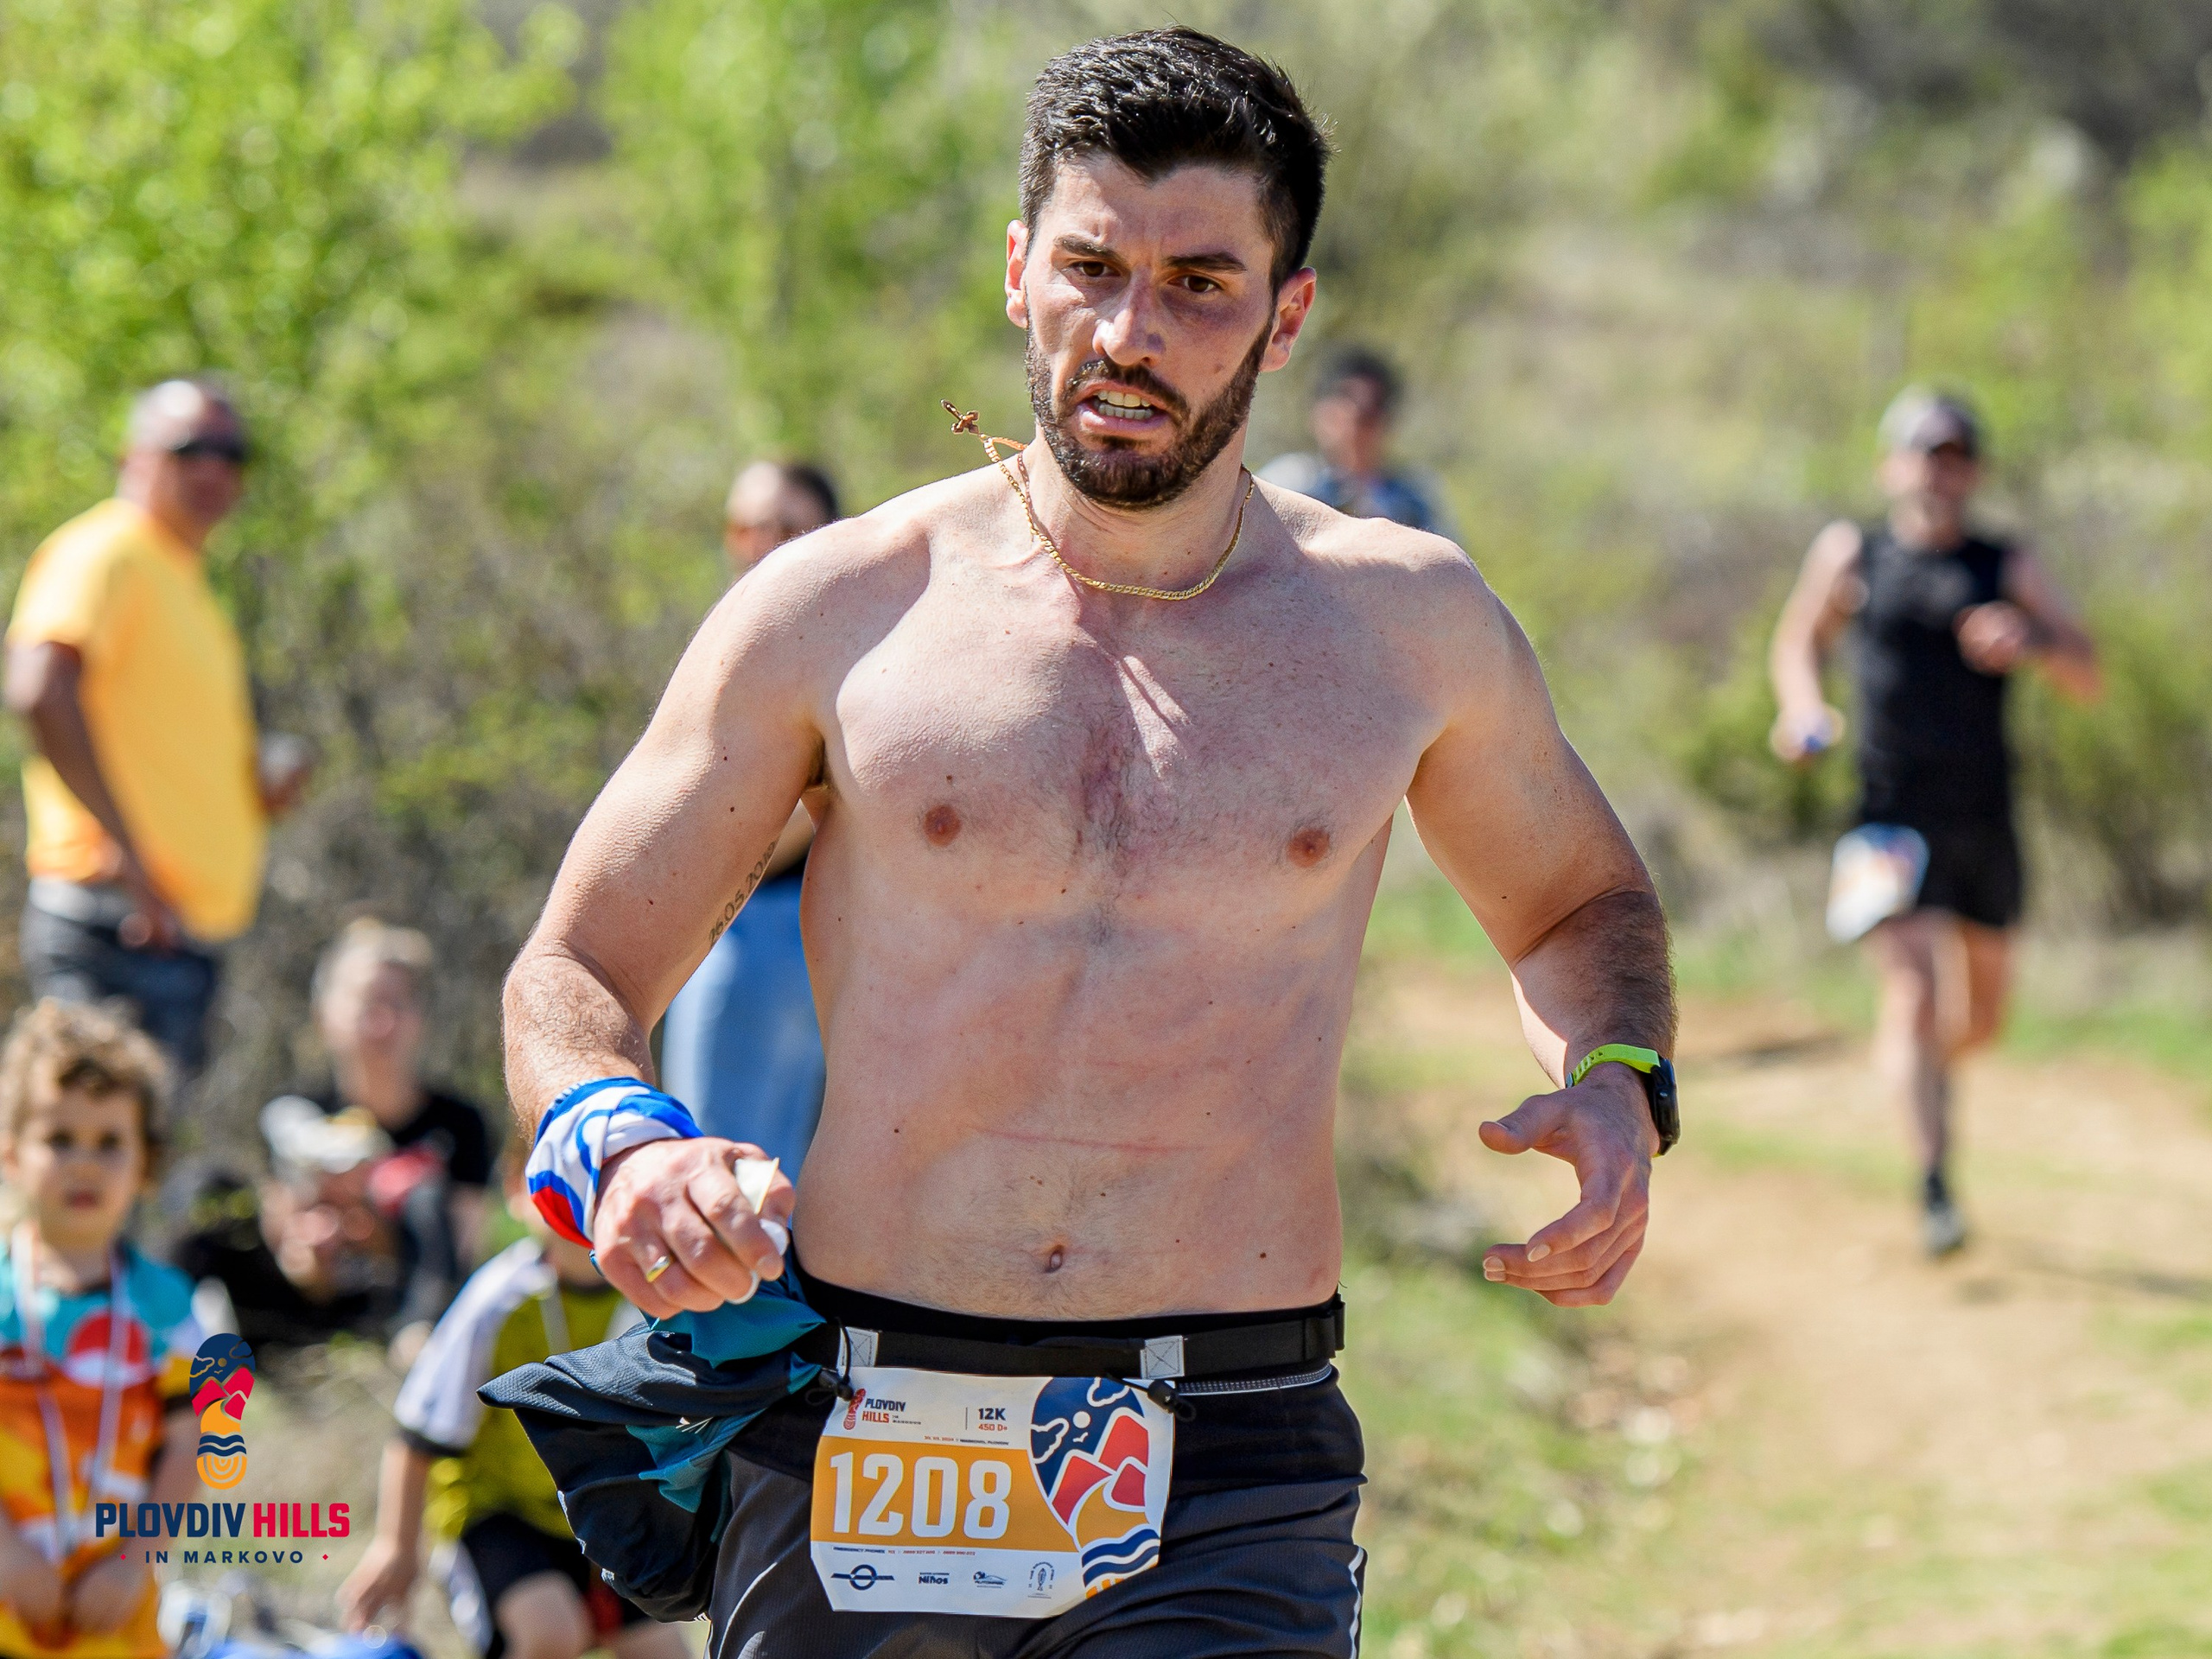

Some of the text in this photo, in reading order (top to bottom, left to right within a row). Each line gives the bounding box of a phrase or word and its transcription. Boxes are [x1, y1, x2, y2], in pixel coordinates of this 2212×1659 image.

[864, 1398, 906, 1412] PLOVDIV
[861, 1411, 889, 1423] HILLS
[978, 1408, 1006, 1421] 12K
[830, 1451, 1012, 1540] 1208
